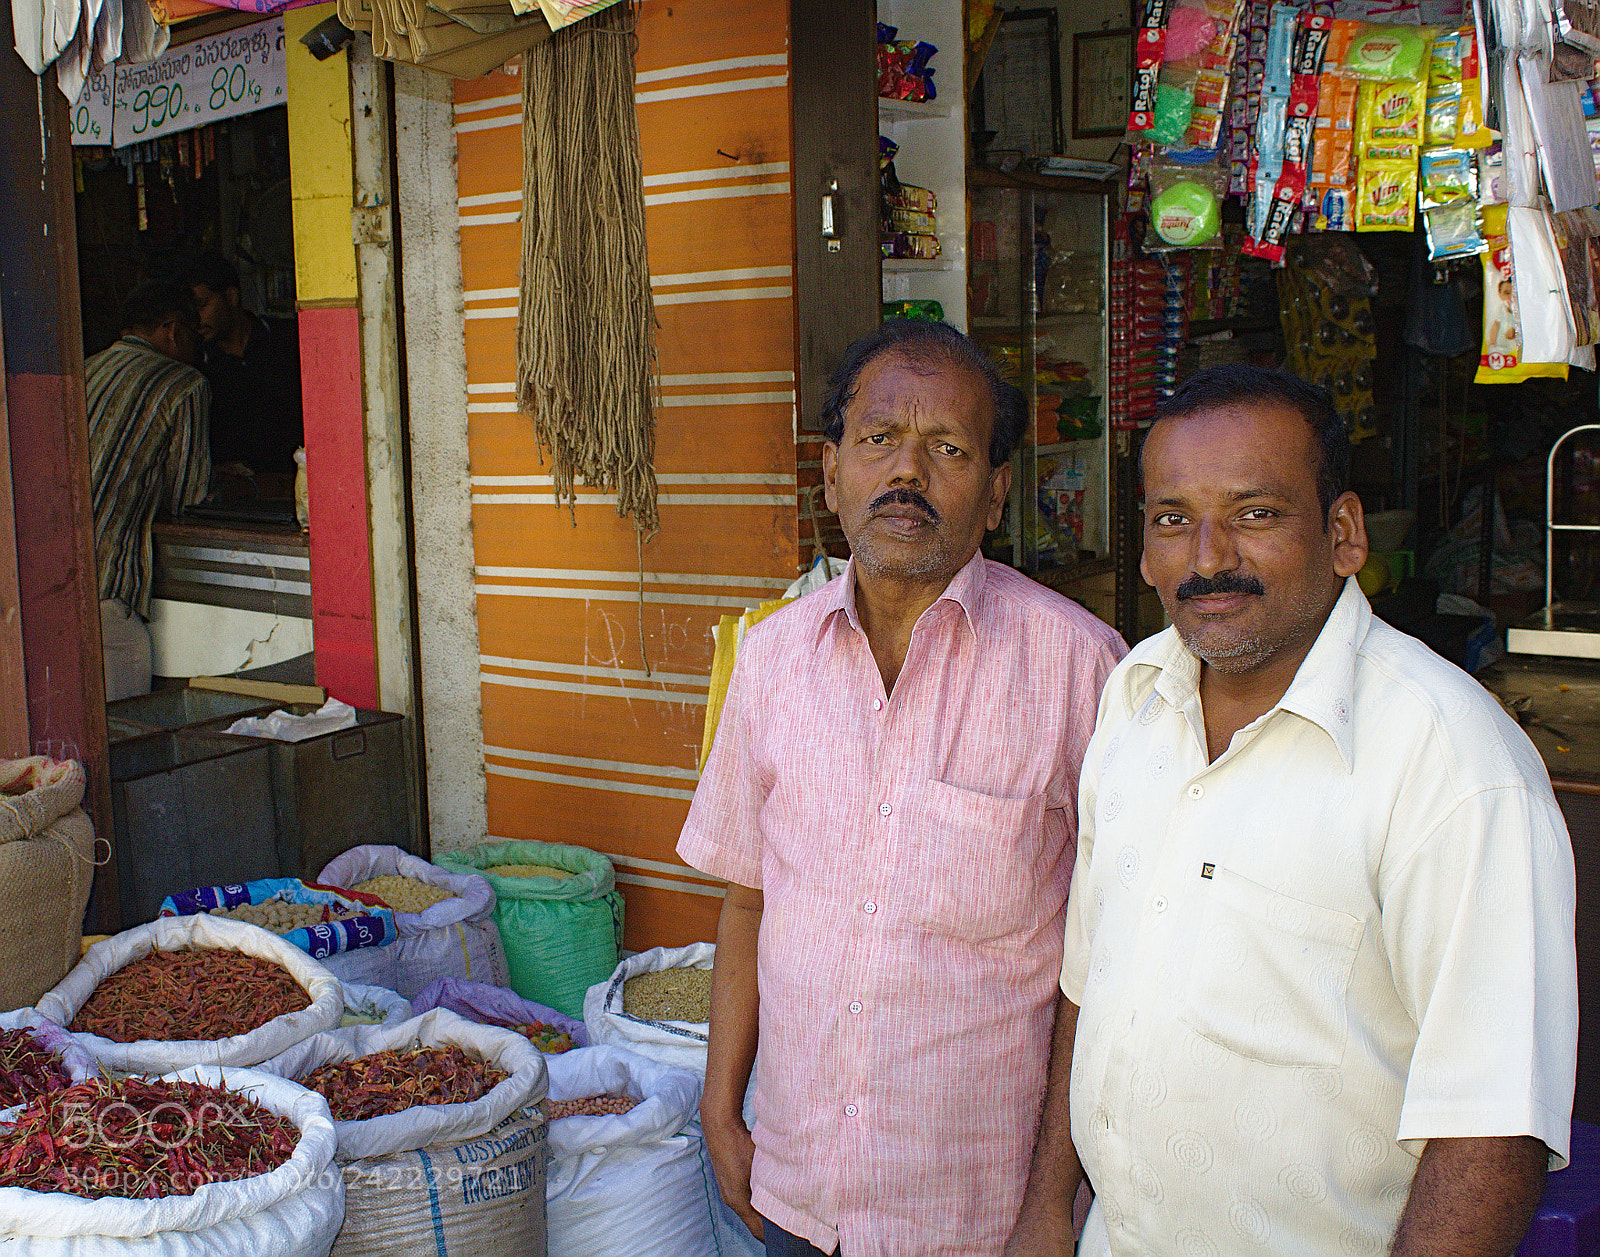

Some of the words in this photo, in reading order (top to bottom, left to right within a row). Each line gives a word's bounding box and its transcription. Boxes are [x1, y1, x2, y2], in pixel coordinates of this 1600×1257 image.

[1302, 30, 1323, 75] Ratol
[133, 82, 183, 135] 990
[209, 64, 246, 110] 80
[1134, 68, 1151, 111] Ratol
[1381, 94, 1411, 119] Vim
[1286, 117, 1308, 162] Ratol
[1371, 184, 1400, 206] Vim
[1268, 201, 1290, 246] Ratol
